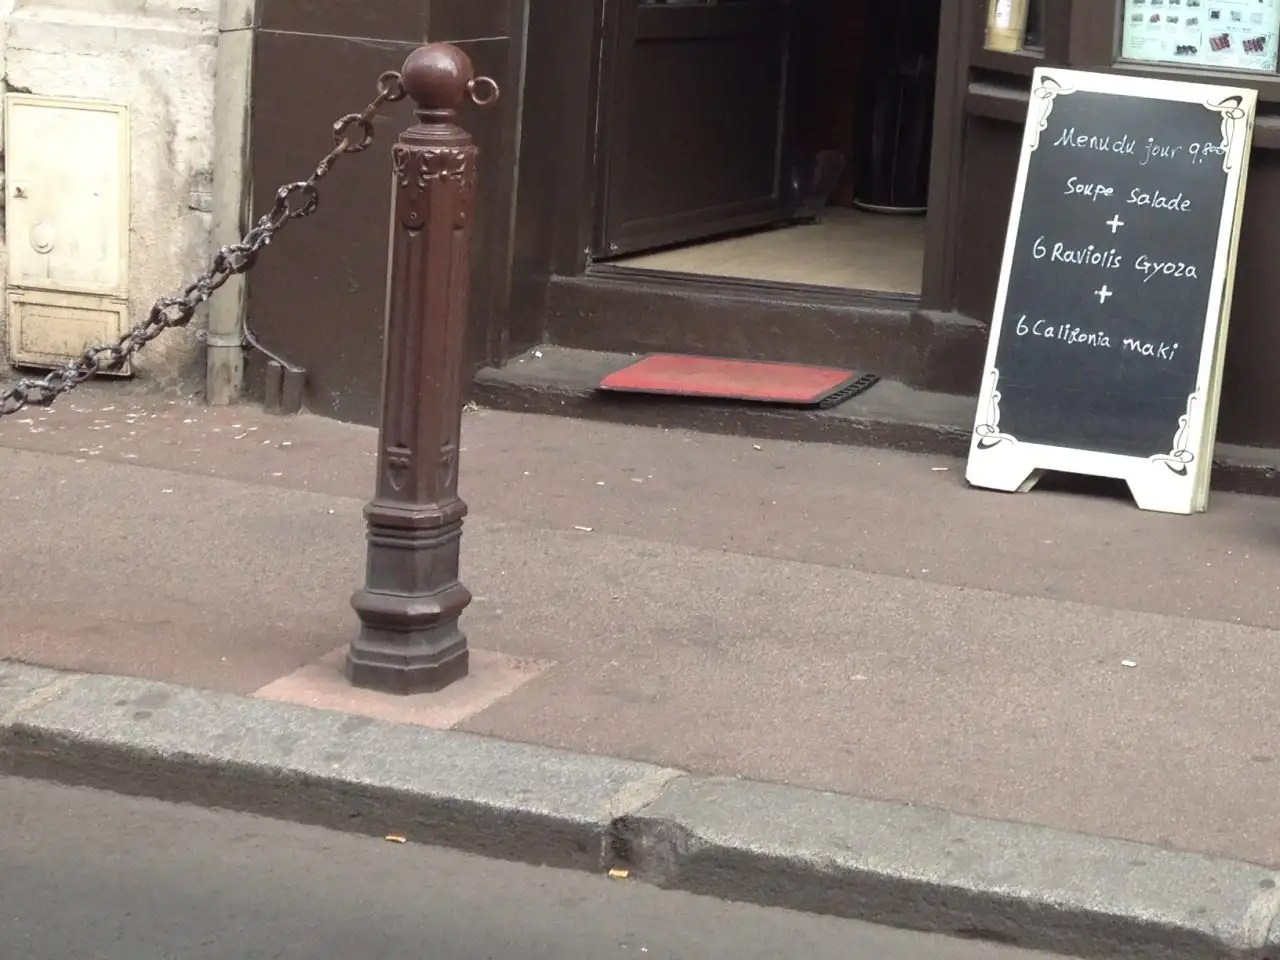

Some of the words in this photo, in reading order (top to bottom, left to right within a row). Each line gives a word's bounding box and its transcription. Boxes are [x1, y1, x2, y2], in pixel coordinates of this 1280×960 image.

[1053, 127, 1110, 151] Menu
[1112, 134, 1136, 155] du
[1140, 137, 1182, 166] jour
[1063, 176, 1115, 202] Soupe
[1126, 187, 1192, 212] Salade
[1032, 235, 1047, 259] 6
[1051, 242, 1122, 269] Raviolis
[1134, 254, 1198, 283] Gyoza
[1015, 315, 1029, 336] 6
